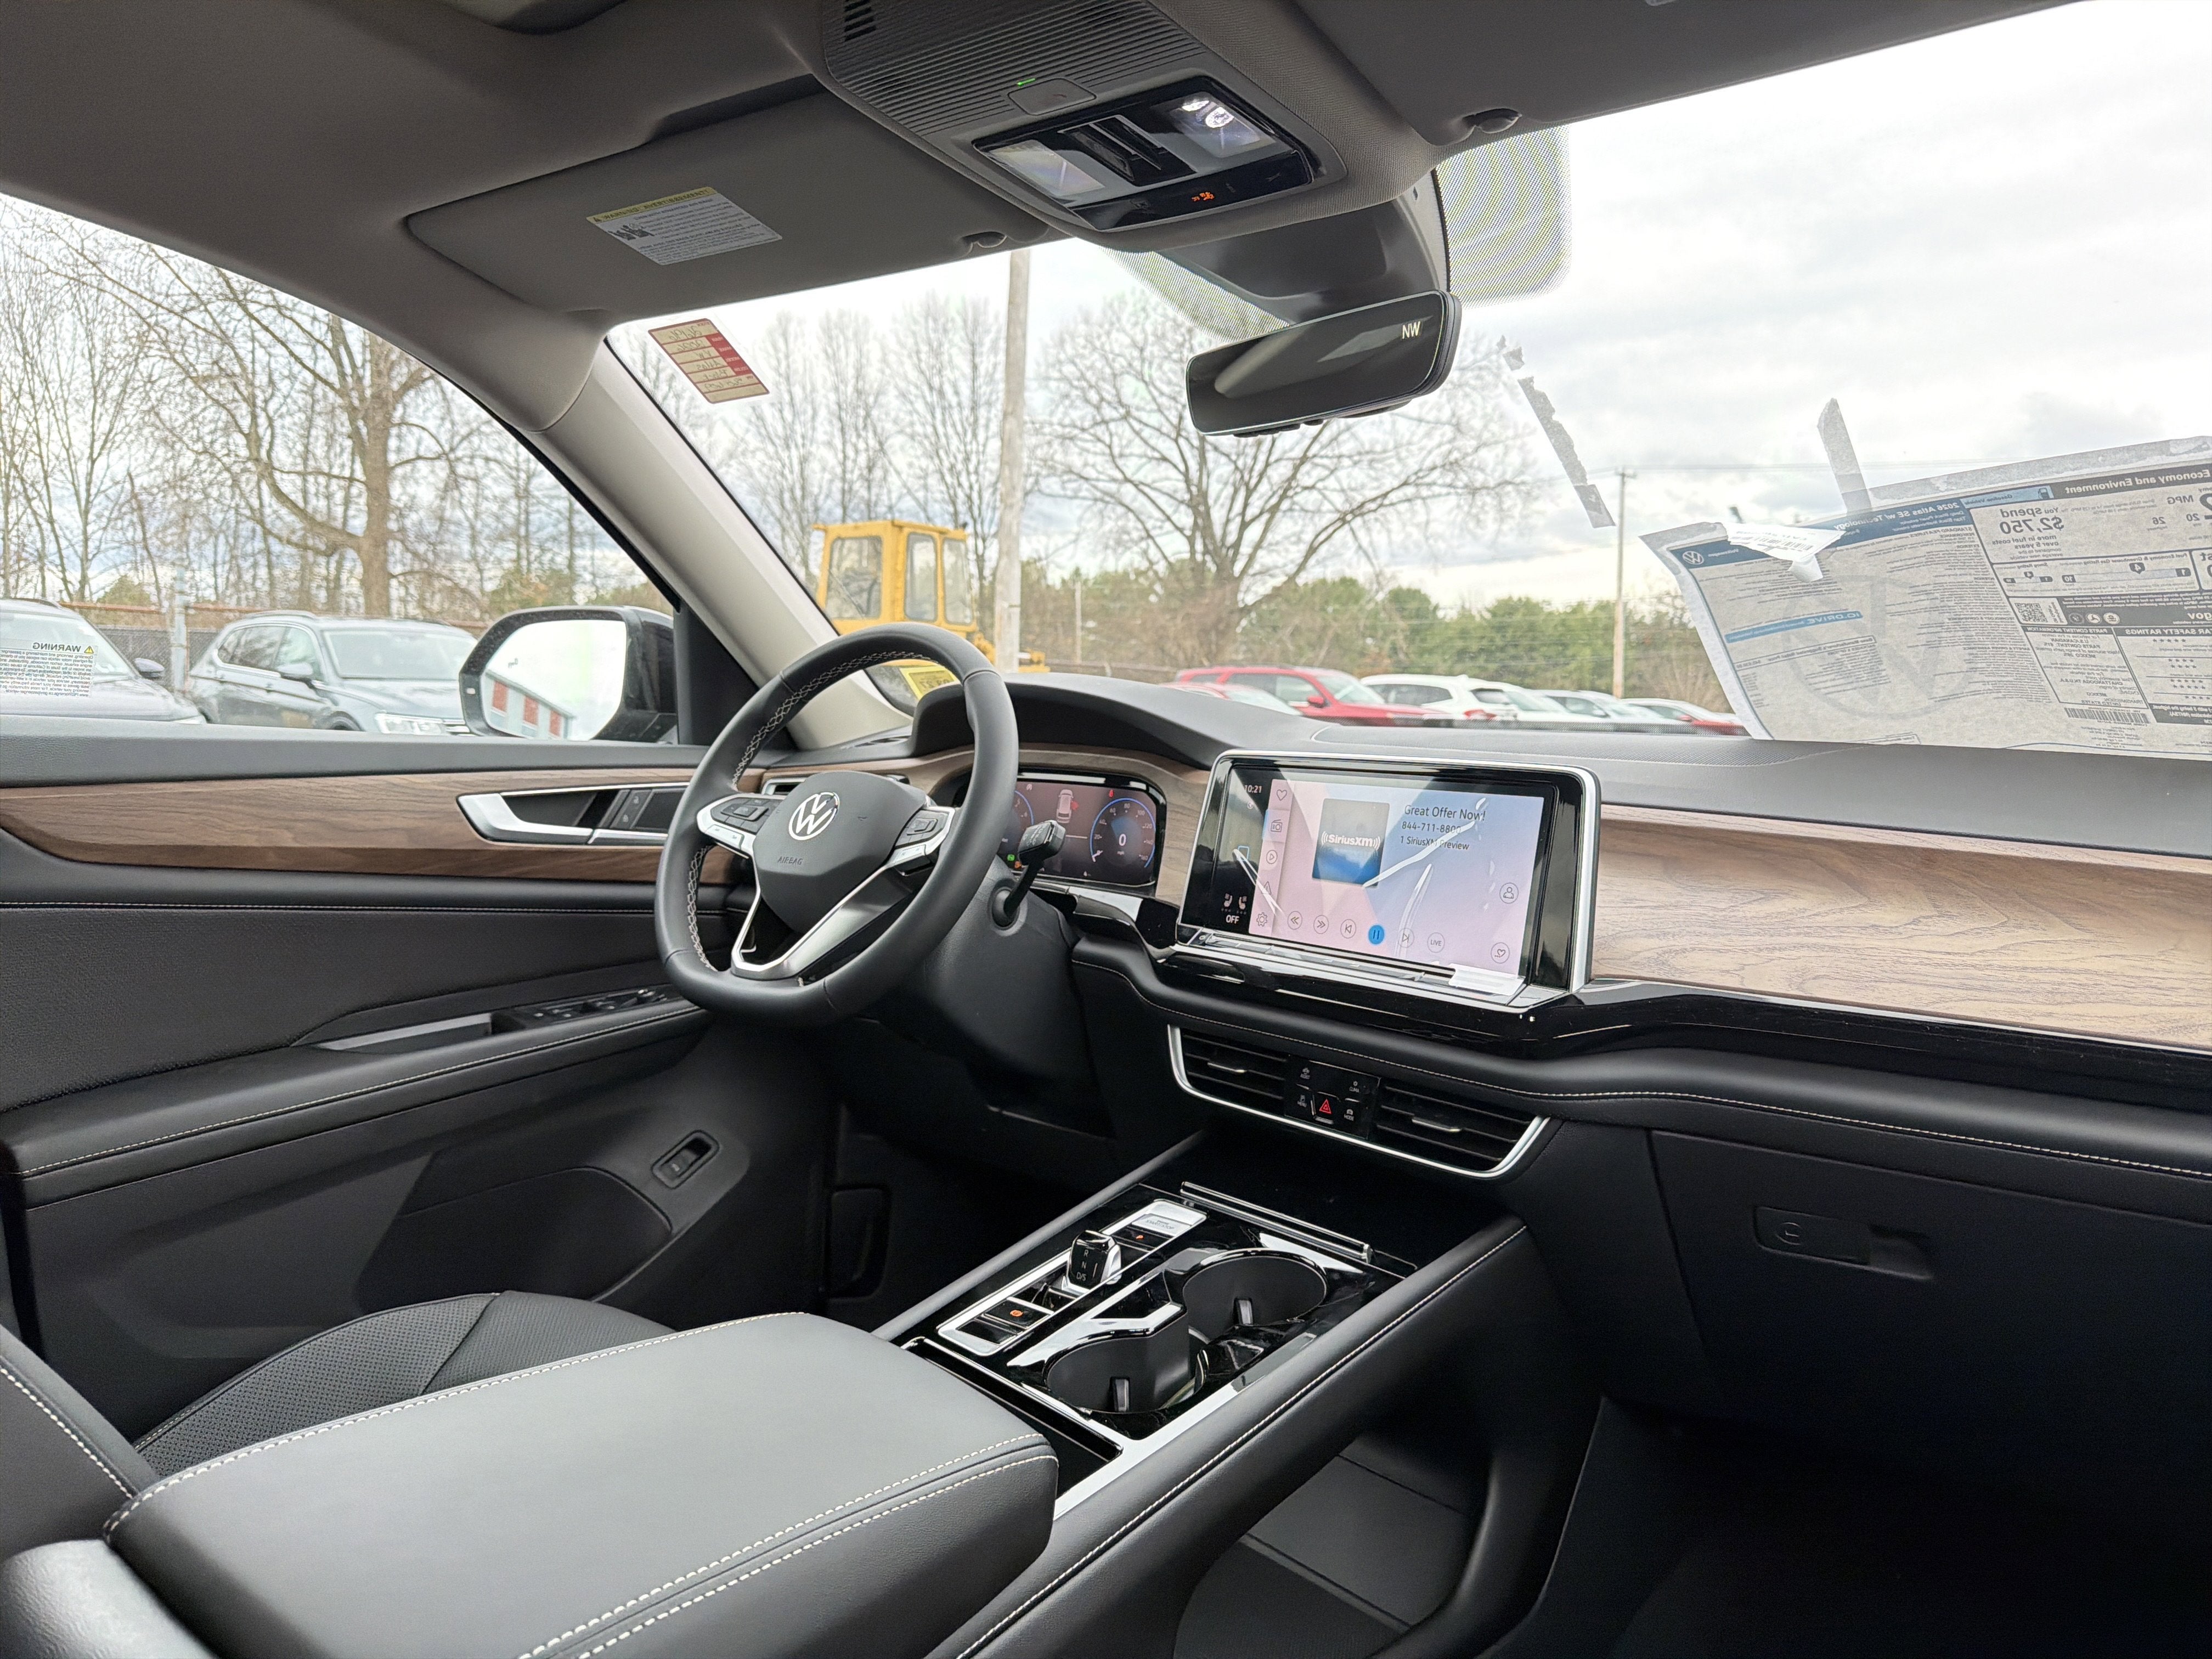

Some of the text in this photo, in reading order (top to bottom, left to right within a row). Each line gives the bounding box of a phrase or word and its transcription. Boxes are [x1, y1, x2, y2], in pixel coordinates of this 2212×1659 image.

[1402, 321, 1420, 339] NW
[1245, 785, 1262, 793] 10:21
[1404, 804, 1486, 821] Great Offer Now!
[1402, 821, 1462, 833] 844-711-8800
[1119, 833, 1126, 846] 0
[1407, 836, 1437, 847] SiriusXM
[1440, 839, 1470, 850] Preview
[777, 856, 803, 865] AIRBAG
[1226, 915, 1240, 924] OFF
[1076, 1272, 1086, 1281] D/S
